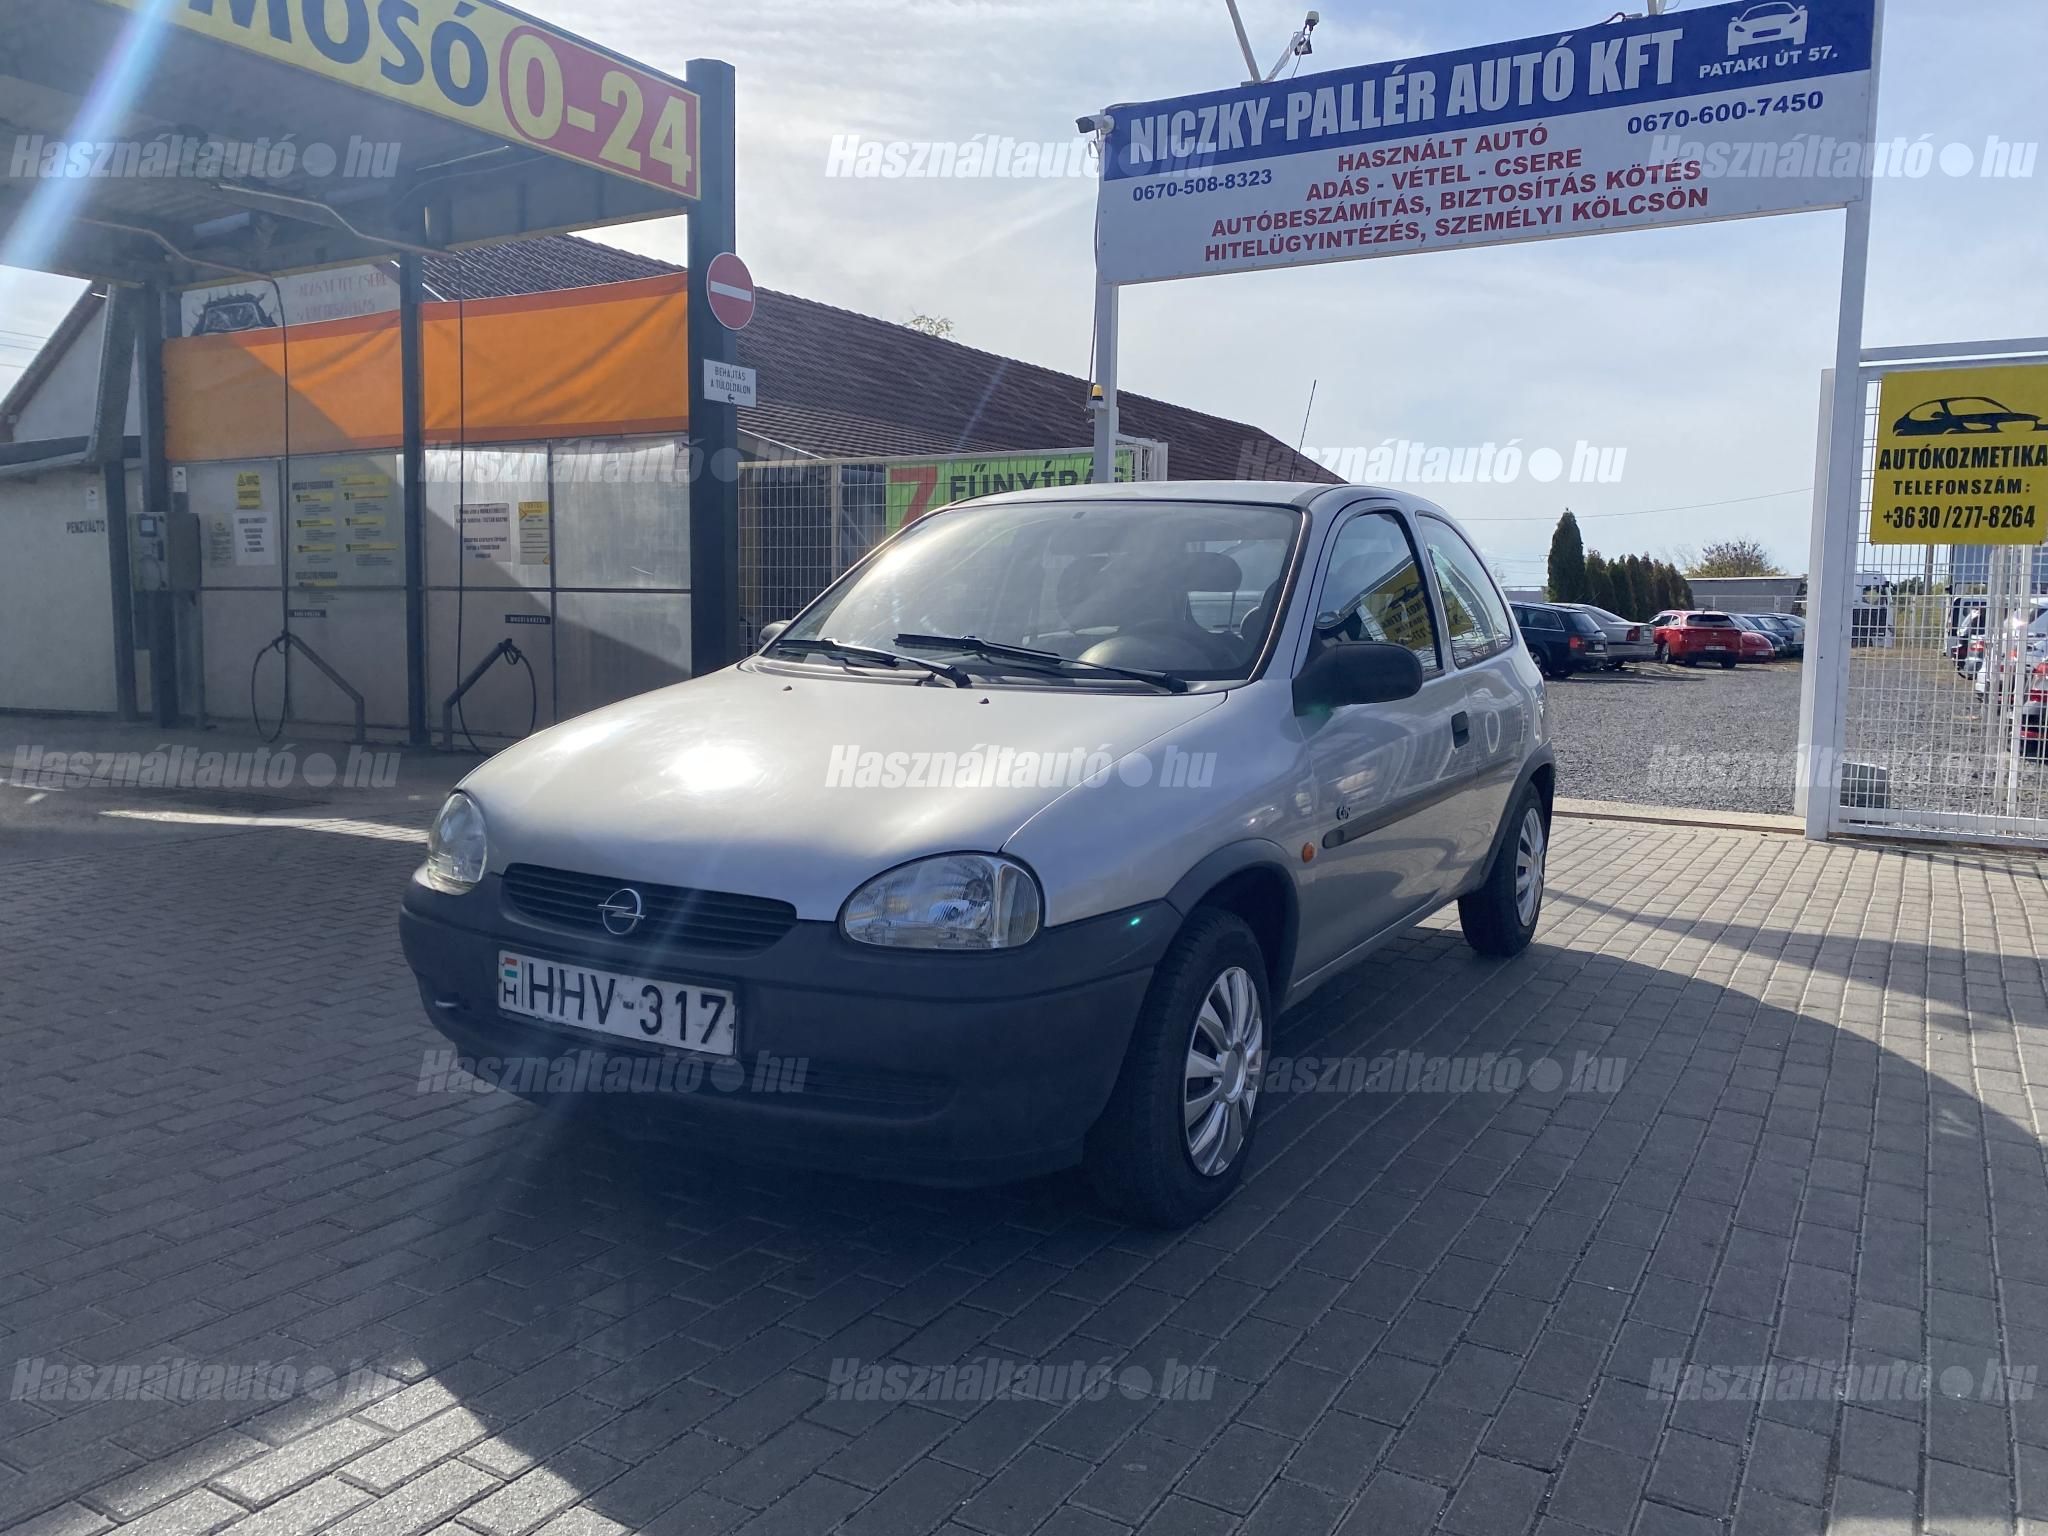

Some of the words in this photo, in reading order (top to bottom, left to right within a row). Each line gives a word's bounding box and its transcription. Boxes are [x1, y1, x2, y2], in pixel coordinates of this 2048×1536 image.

[1699, 55, 1768, 78] PATAKI
[1775, 44, 1802, 66] ÚT
[1808, 45, 1838, 62] 57.
[508, 34, 691, 187] 0-24
[1130, 64, 1436, 165] NICZKY-PALLÉR
[1446, 35, 1575, 116] AUTÓ
[1589, 28, 1683, 96] KFT
[1627, 91, 1824, 134] 0670-600-7450
[1338, 137, 1468, 172] HASZNÁLT
[1475, 122, 1548, 154] AUTÓ
[1132, 169, 1272, 202] 0670-508-8323
[1211, 193, 1431, 237] AUTÓBESZÁMÍTÁS,
[1440, 172, 1597, 211] BIZTOSÍTÁS
[1606, 158, 1701, 190] KÖTÉS
[1306, 175, 1370, 201] ADÁS
[1391, 165, 1471, 191] VÉTEL
[1494, 148, 1582, 177] CSERE
[1205, 219, 1426, 262] HITELÜGYINTÉZÉS,
[1434, 204, 1562, 236] SZEMÉLYI
[1571, 187, 1709, 222] KÖLCSÖN
[951, 457, 1125, 501] FŰNYÍR
[1878, 444, 2048, 470] AUTÓKOZMETIKA
[503, 982, 517, 1005] H
[529, 963, 727, 1044] HHV-317
